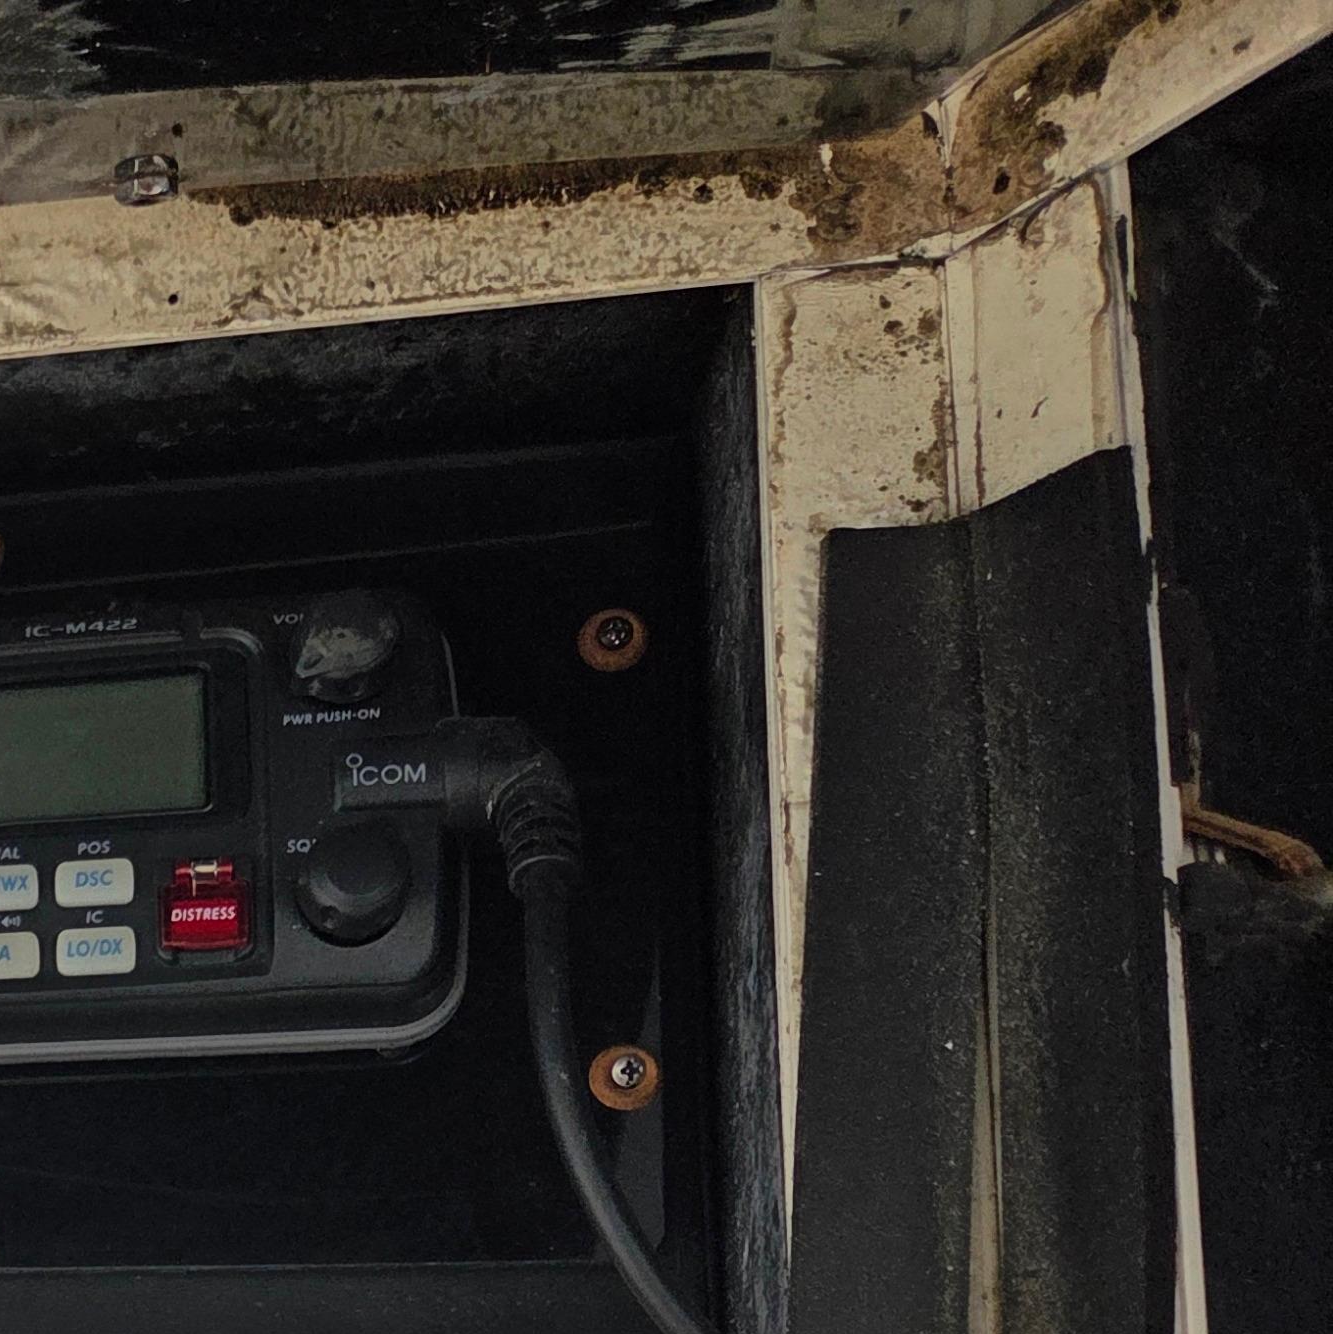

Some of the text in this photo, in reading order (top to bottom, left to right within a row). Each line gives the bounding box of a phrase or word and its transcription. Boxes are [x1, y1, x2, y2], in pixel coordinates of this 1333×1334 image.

[25, 617, 138, 638] IC-M422
[282, 713, 313, 726] PWR
[77, 841, 111, 855] POS
[286, 838, 316, 854] SQ
[75, 869, 114, 888] DSC
[85, 910, 104, 924] IC
[171, 905, 237, 923] DISTRESS
[66, 938, 123, 958] LO/DX
